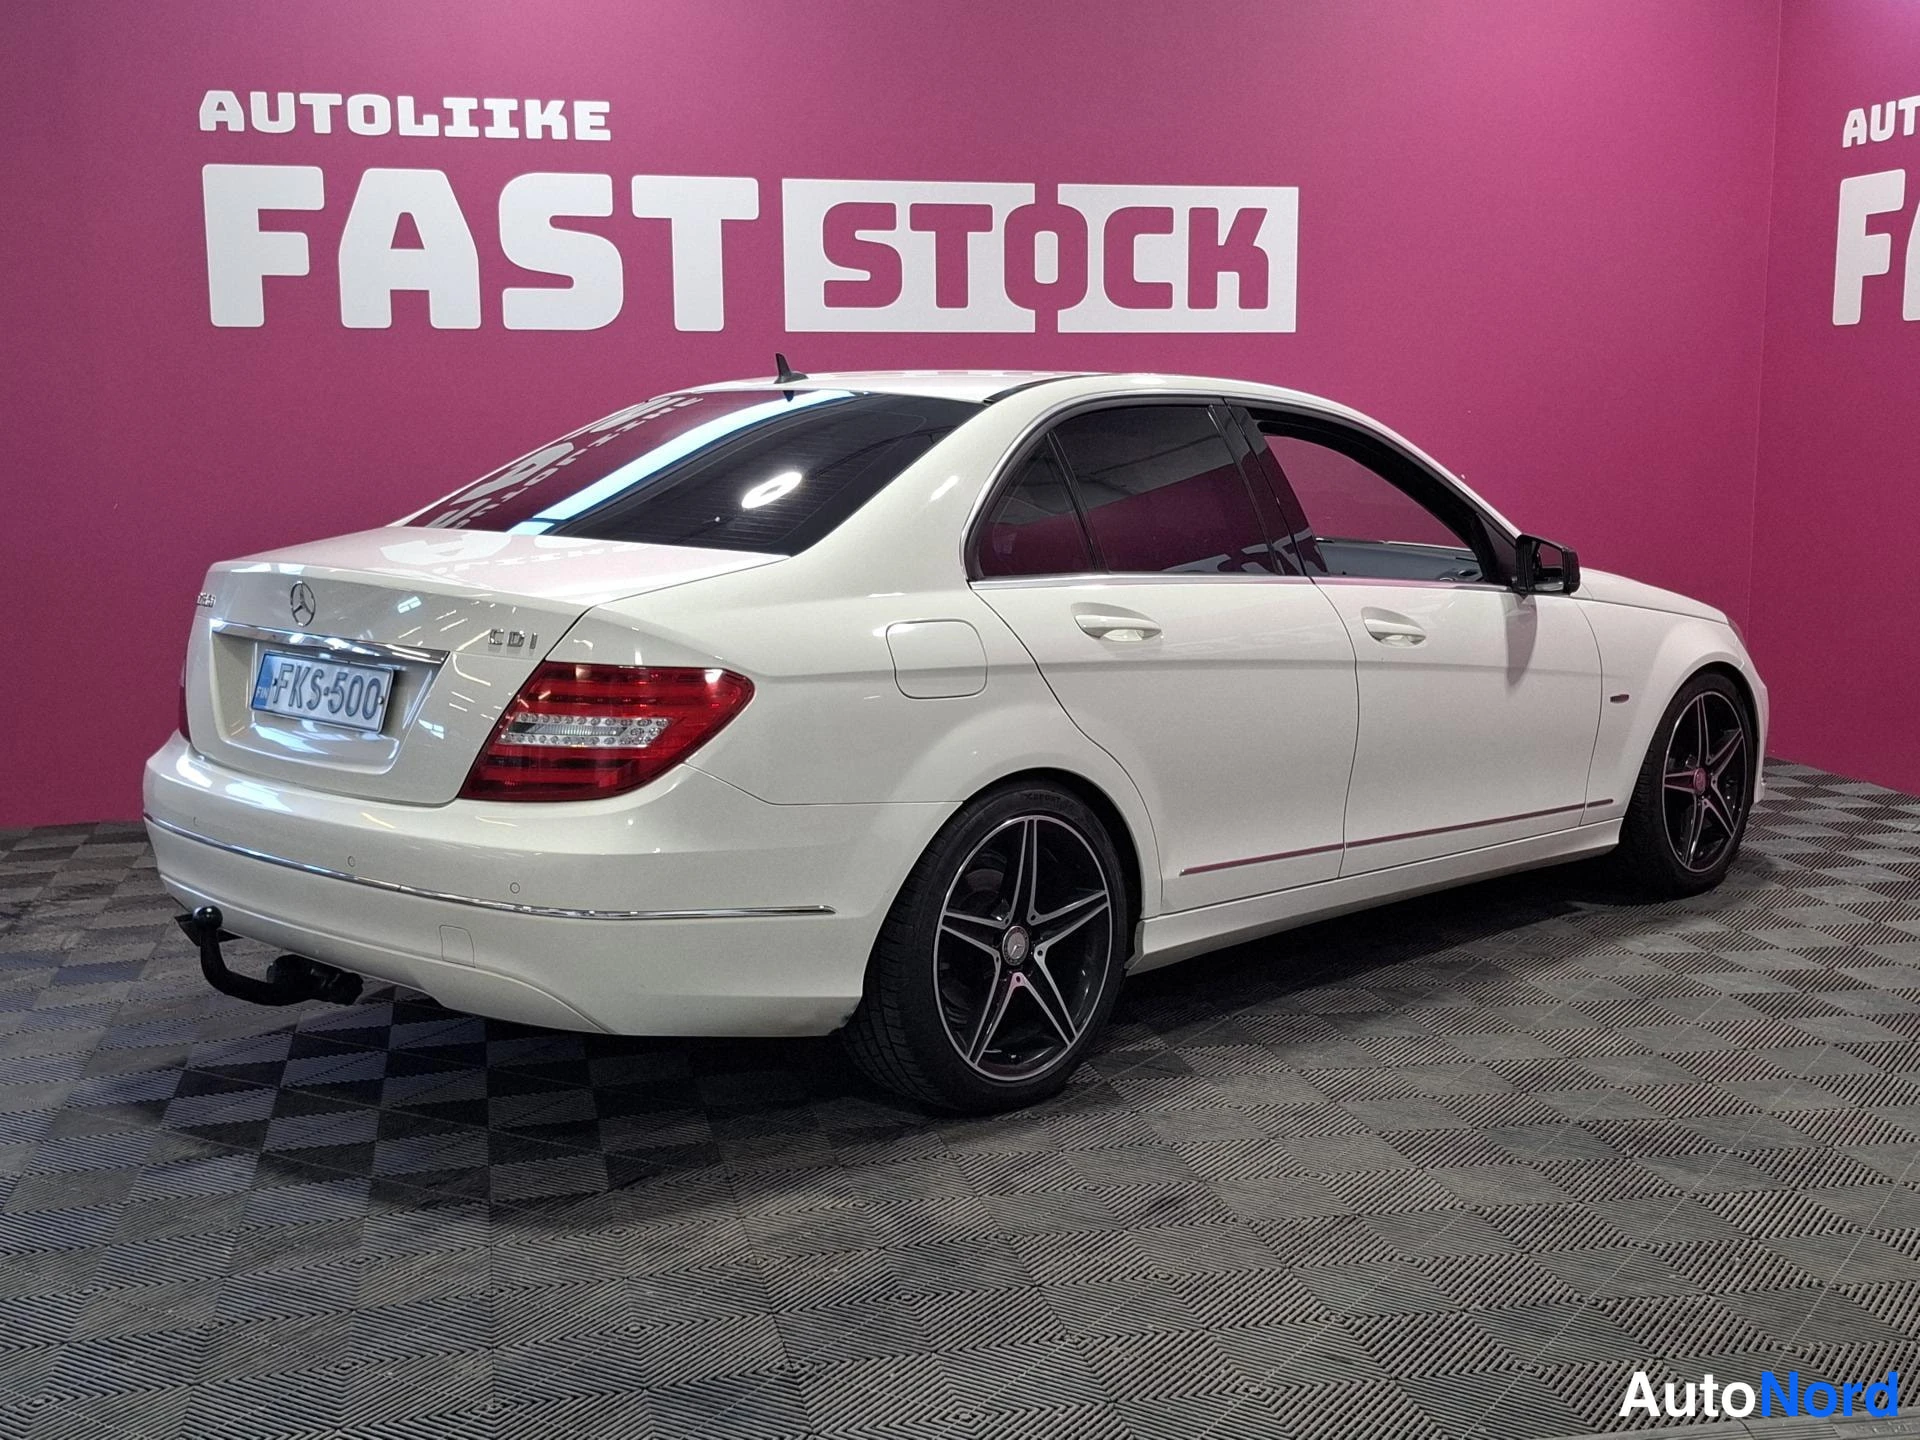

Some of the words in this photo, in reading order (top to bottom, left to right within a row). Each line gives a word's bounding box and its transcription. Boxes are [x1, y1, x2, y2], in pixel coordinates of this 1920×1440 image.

[199, 90, 611, 141] AUTOLIIKE
[202, 164, 759, 331] FAST
[823, 201, 1269, 310] STOCK
[1832, 169, 1920, 326] F
[488, 627, 538, 650] CDI
[273, 662, 382, 720] FKS-500
